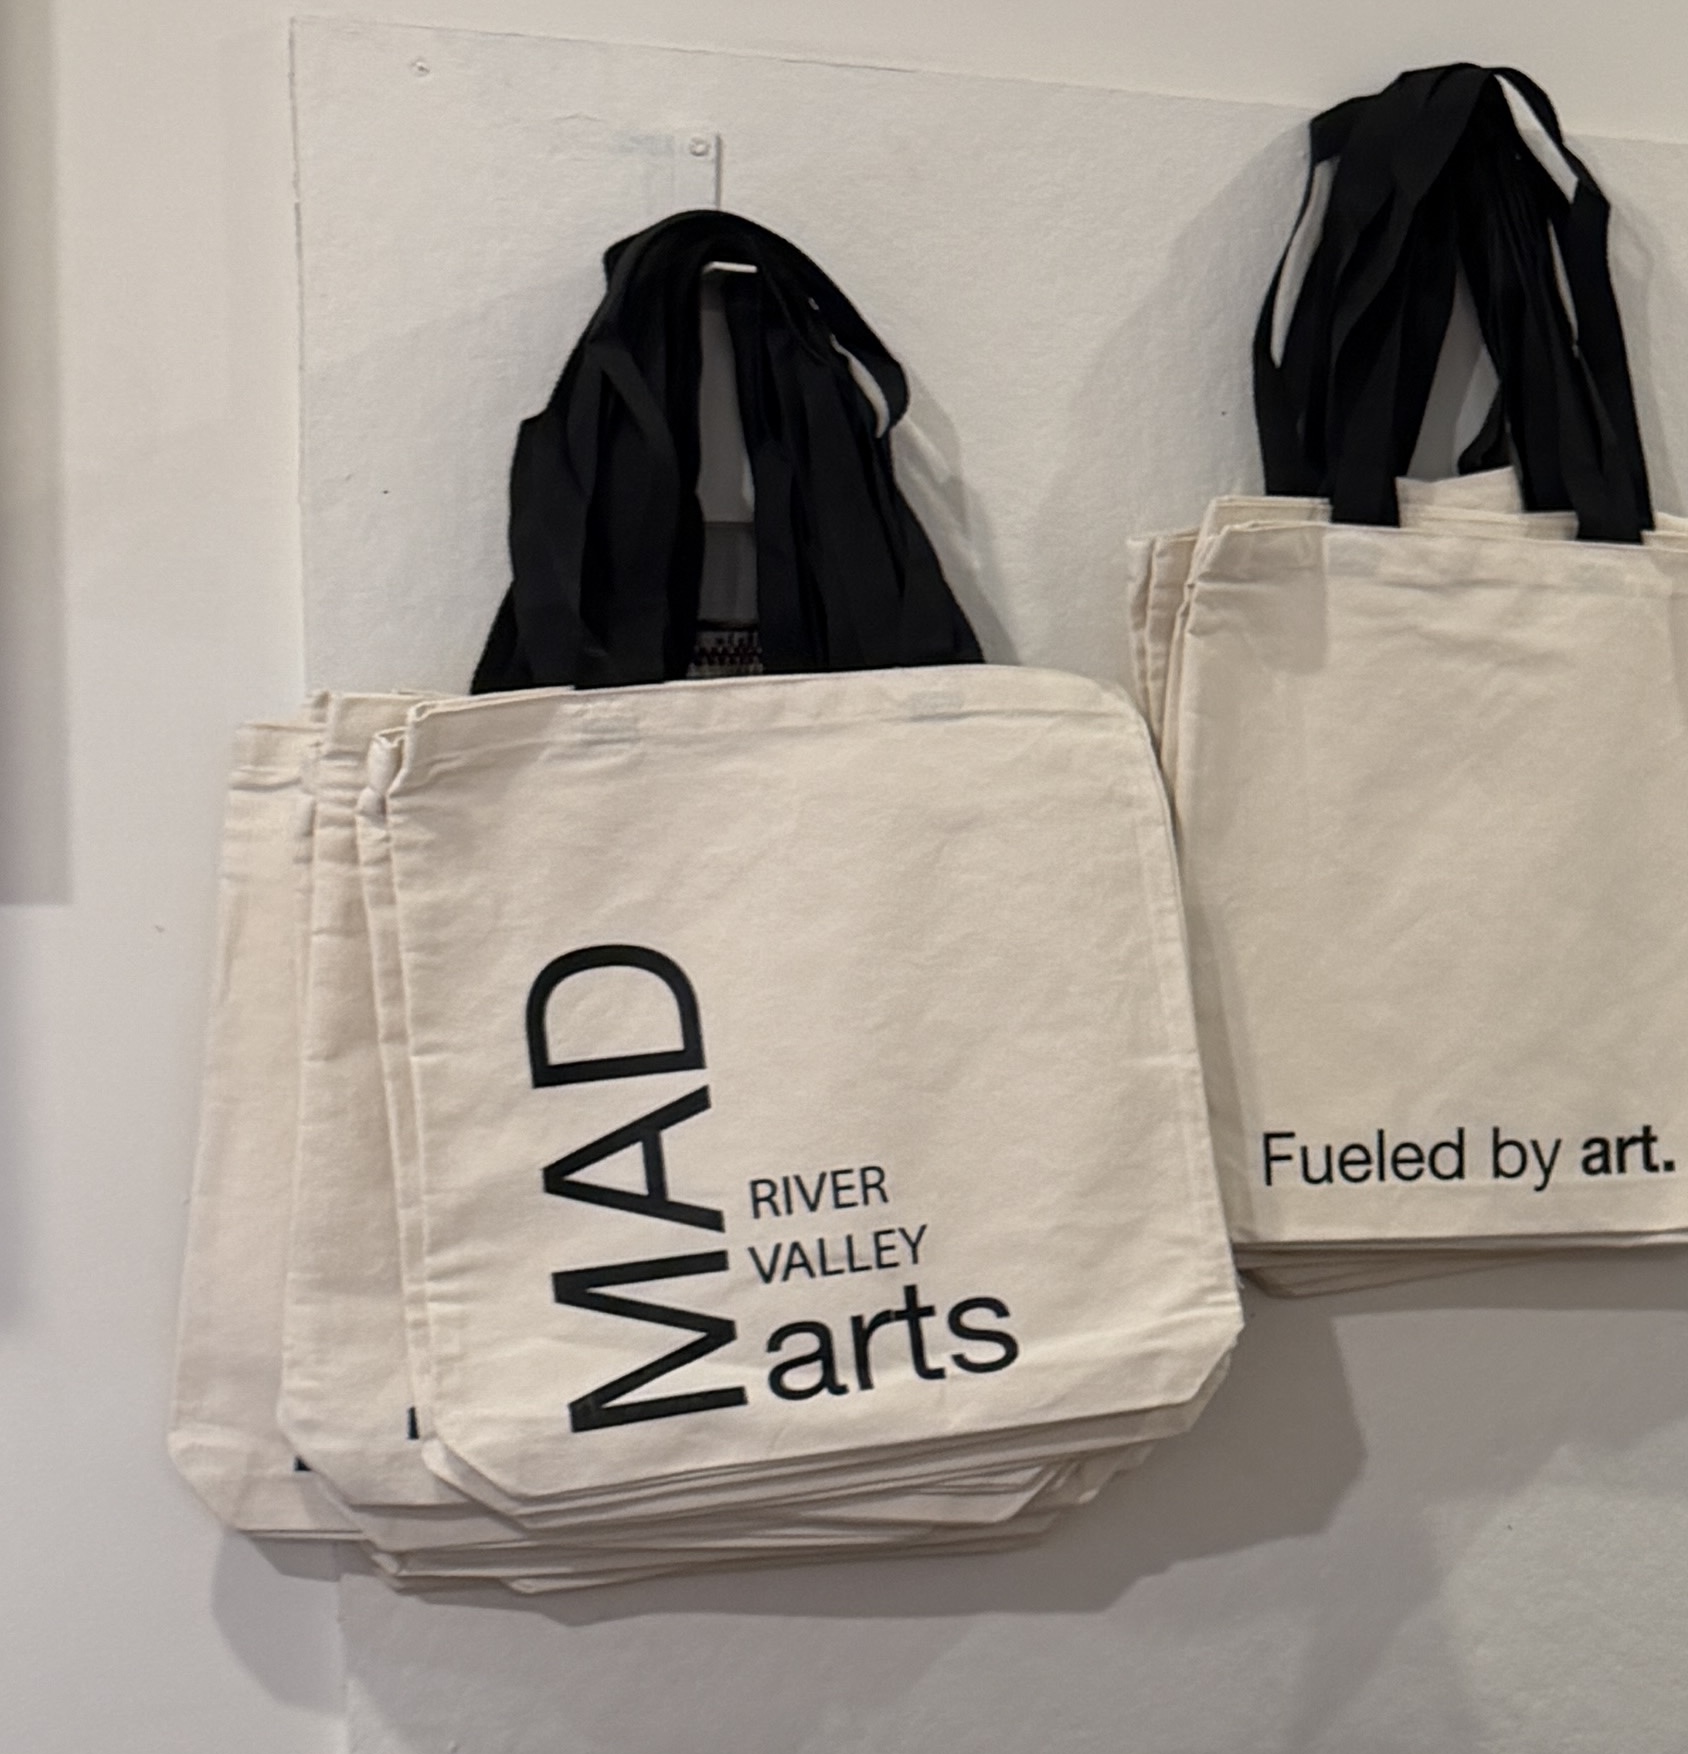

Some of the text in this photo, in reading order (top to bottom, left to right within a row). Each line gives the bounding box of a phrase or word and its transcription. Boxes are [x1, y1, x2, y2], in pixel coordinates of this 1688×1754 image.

[525, 943, 749, 1435] MAD
[749, 1164, 890, 1220] RIVER
[1261, 1124, 1677, 1194] Fueled by art.
[747, 1223, 929, 1286] VALLEY
[765, 1283, 1020, 1402] arts
